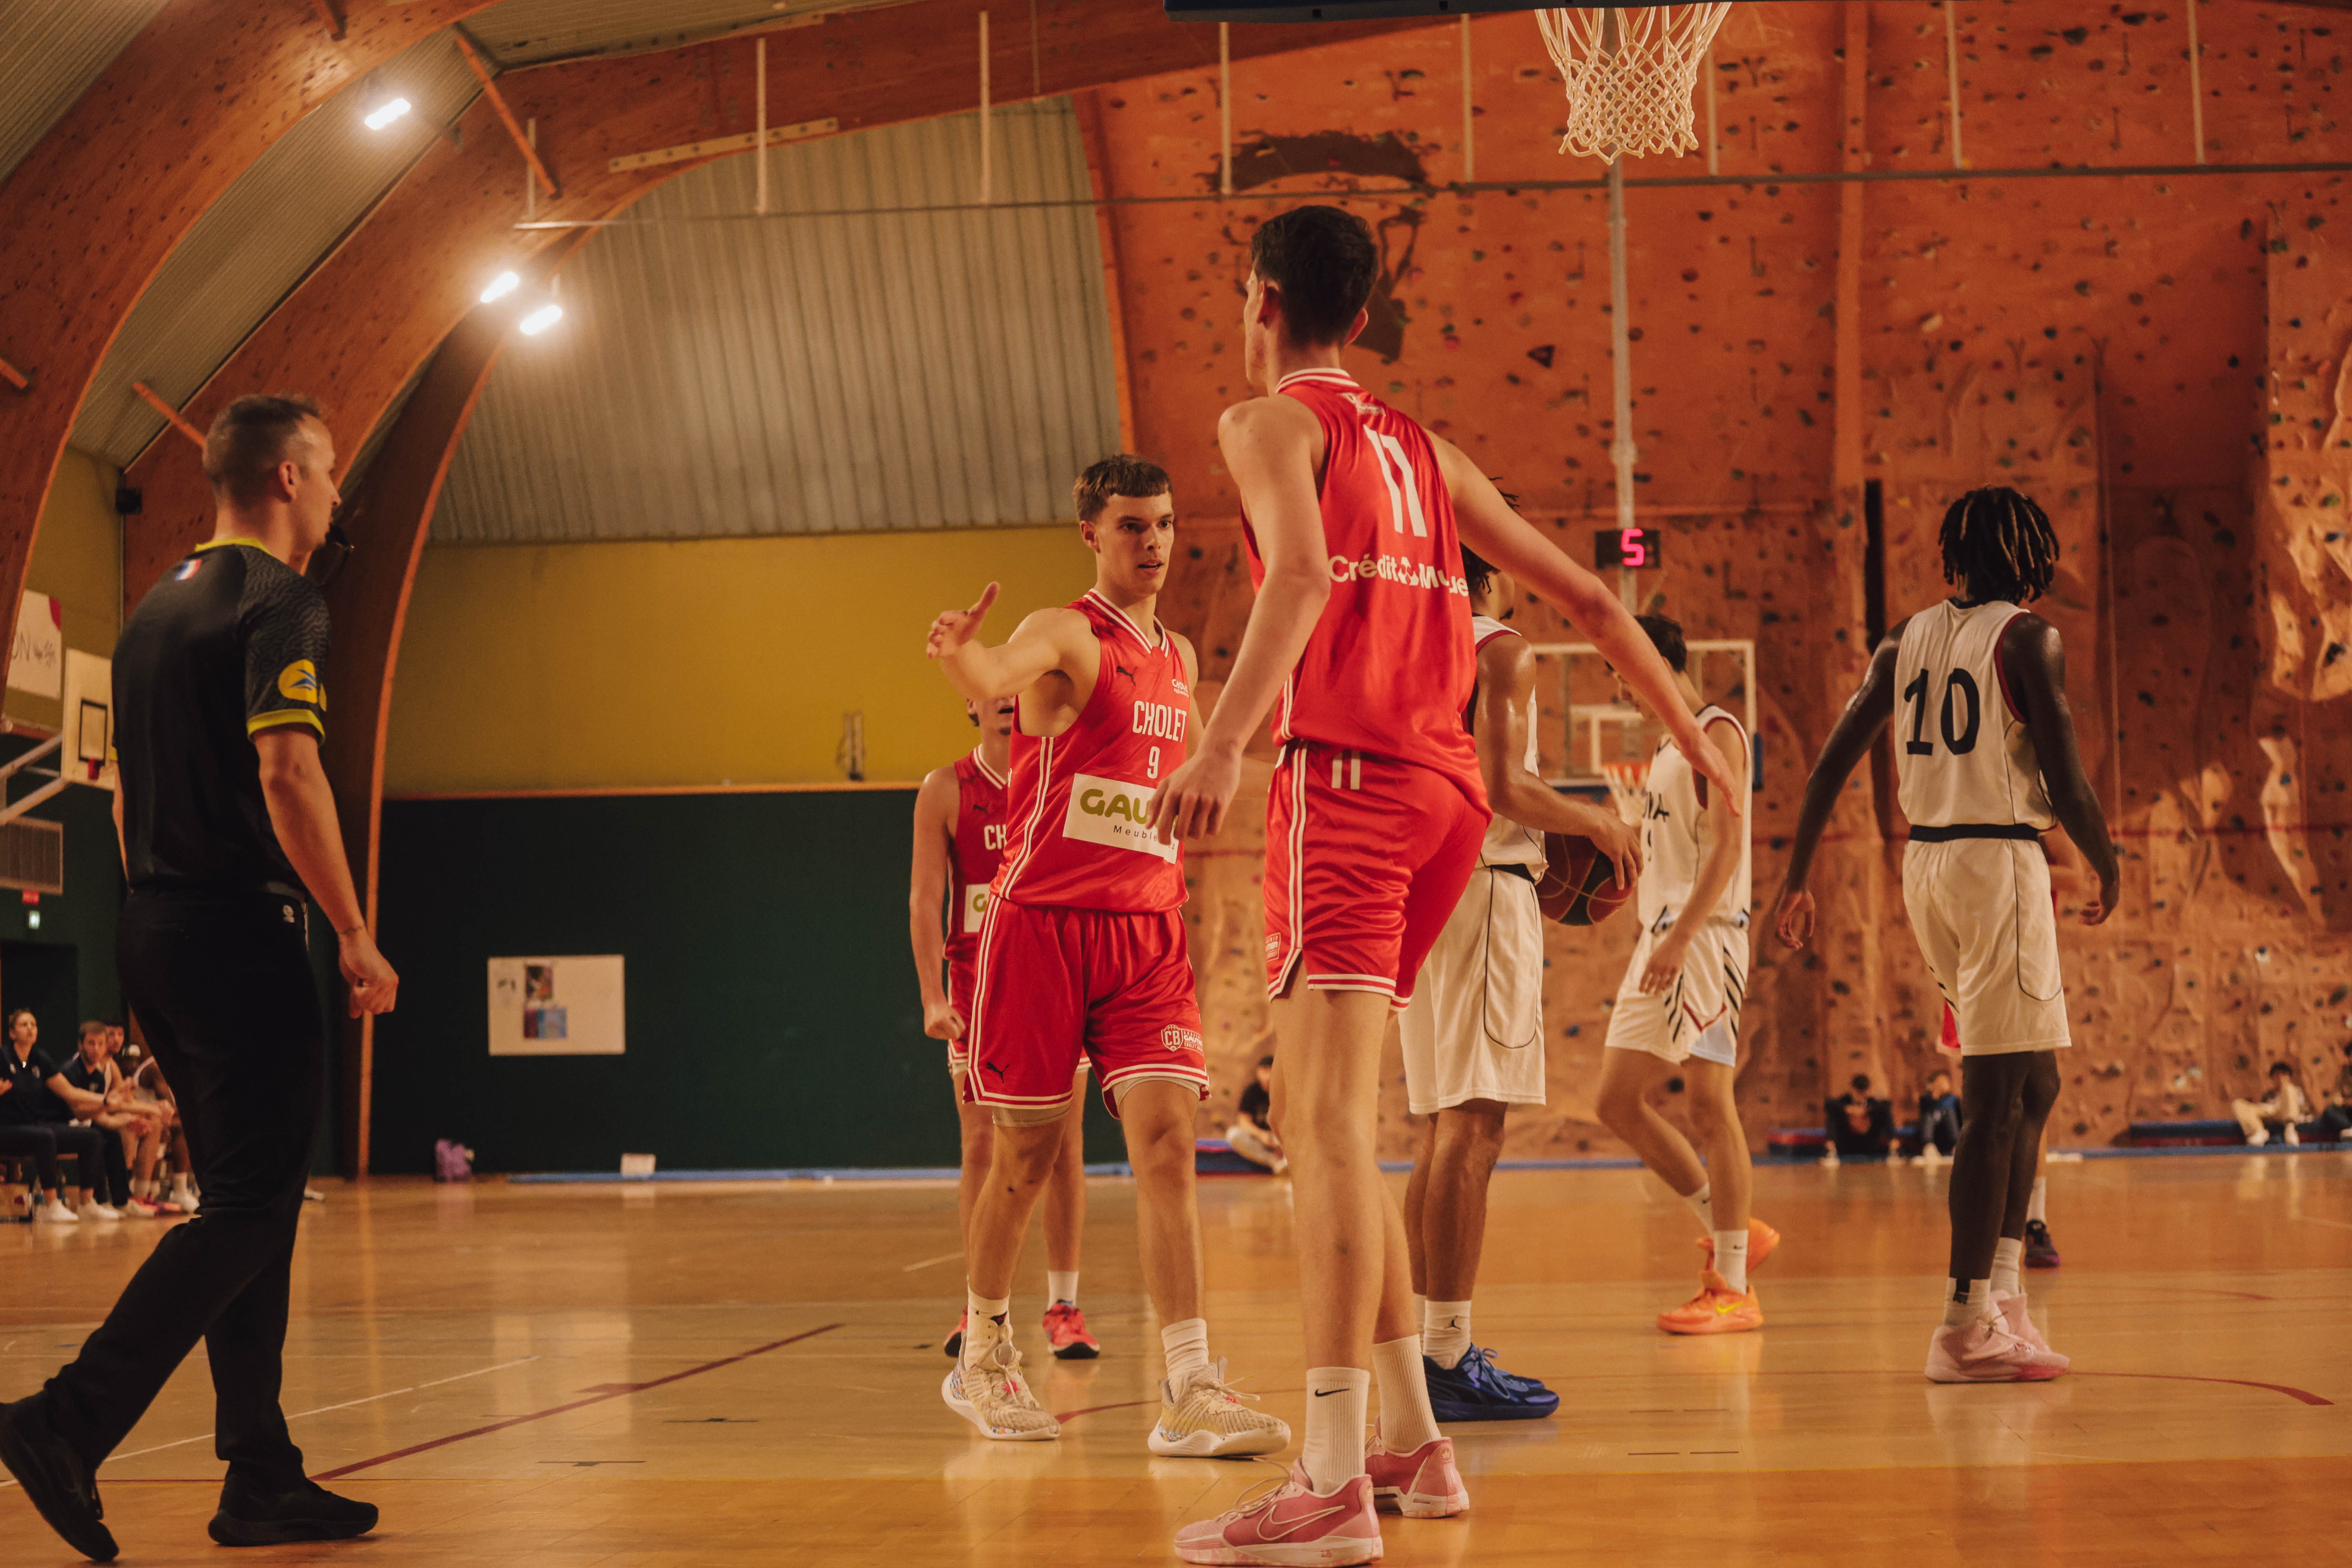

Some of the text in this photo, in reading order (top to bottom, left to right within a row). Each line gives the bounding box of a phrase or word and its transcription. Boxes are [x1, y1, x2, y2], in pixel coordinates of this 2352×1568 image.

[1363, 424, 1427, 537] 11
[1621, 528, 1645, 567] 5
[1328, 554, 1399, 583] Crédit
[1132, 700, 1187, 743] CHOLET
[1904, 668, 1980, 755] 10
[1147, 746, 1160, 779] 9
[1080, 788, 1161, 828] GAU
[984, 824, 1007, 850] CH
[1113, 825, 1157, 841] Meuble
[1165, 1030, 1181, 1045] CB
